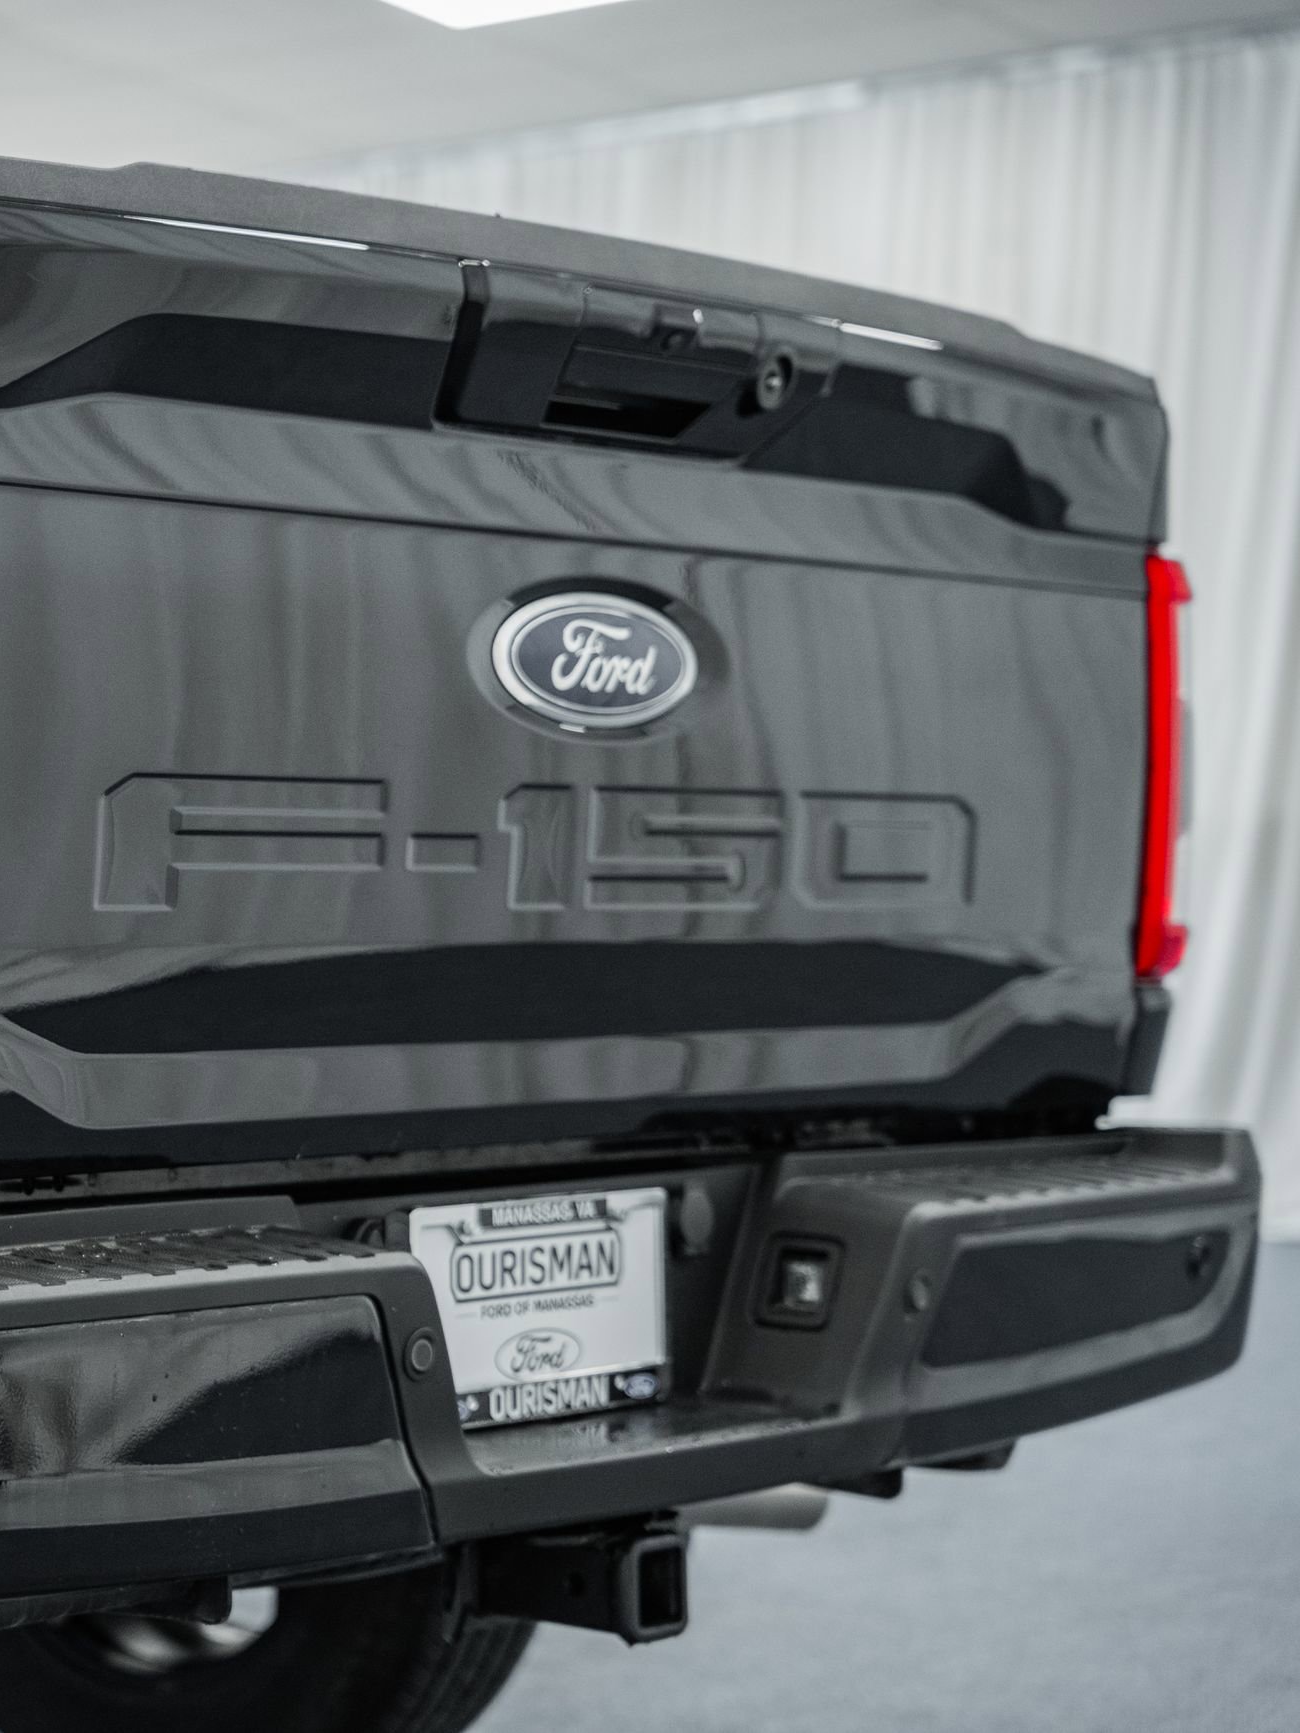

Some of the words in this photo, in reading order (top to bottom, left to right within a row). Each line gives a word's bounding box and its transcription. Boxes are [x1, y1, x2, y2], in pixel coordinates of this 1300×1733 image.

[551, 618, 657, 697] Ford
[93, 772, 977, 912] F-150
[575, 1200, 596, 1220] VA
[456, 1240, 616, 1293] OURISMAN
[480, 1303, 511, 1319] FORD
[515, 1301, 530, 1316] OF
[534, 1294, 594, 1313] MANASSAS
[510, 1334, 566, 1373] Ford
[489, 1375, 609, 1422] OURISMAN
